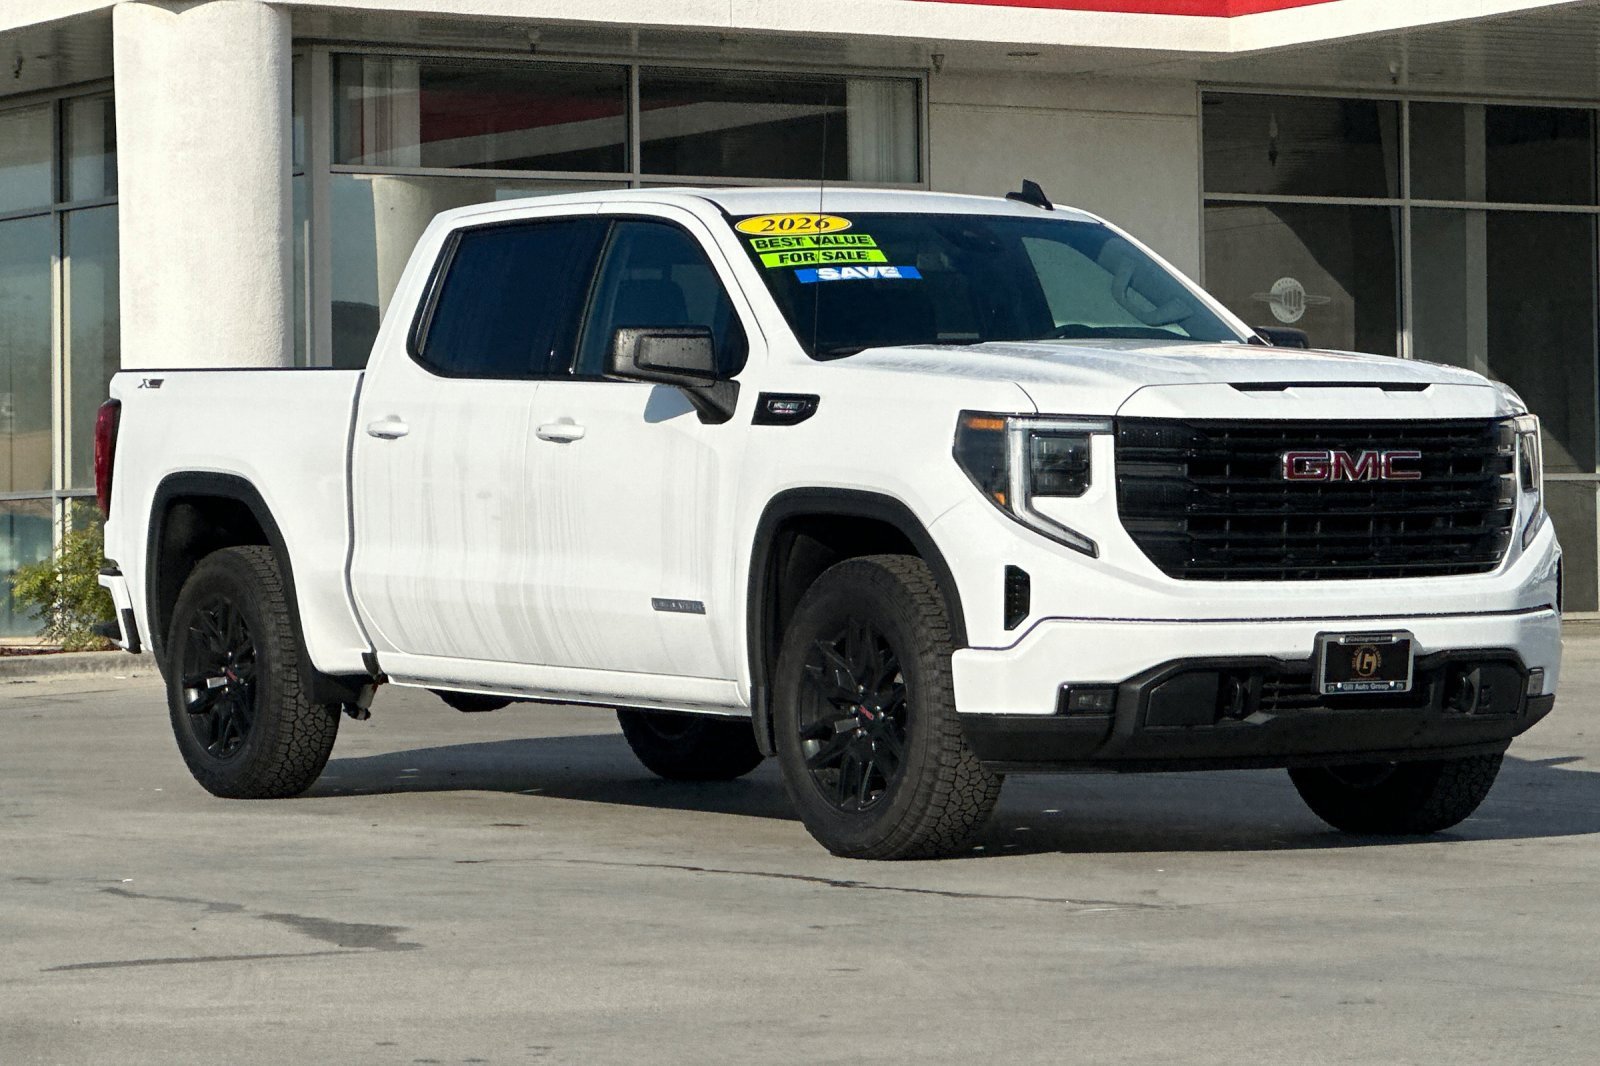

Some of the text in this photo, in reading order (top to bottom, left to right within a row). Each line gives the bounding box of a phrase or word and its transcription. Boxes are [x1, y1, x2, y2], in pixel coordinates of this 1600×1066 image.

[761, 217, 830, 232] 2026
[755, 235, 869, 249] BEST VALUE
[778, 250, 869, 264] FOR SALE
[816, 266, 903, 280] SAVE
[1283, 450, 1421, 481] GMC
